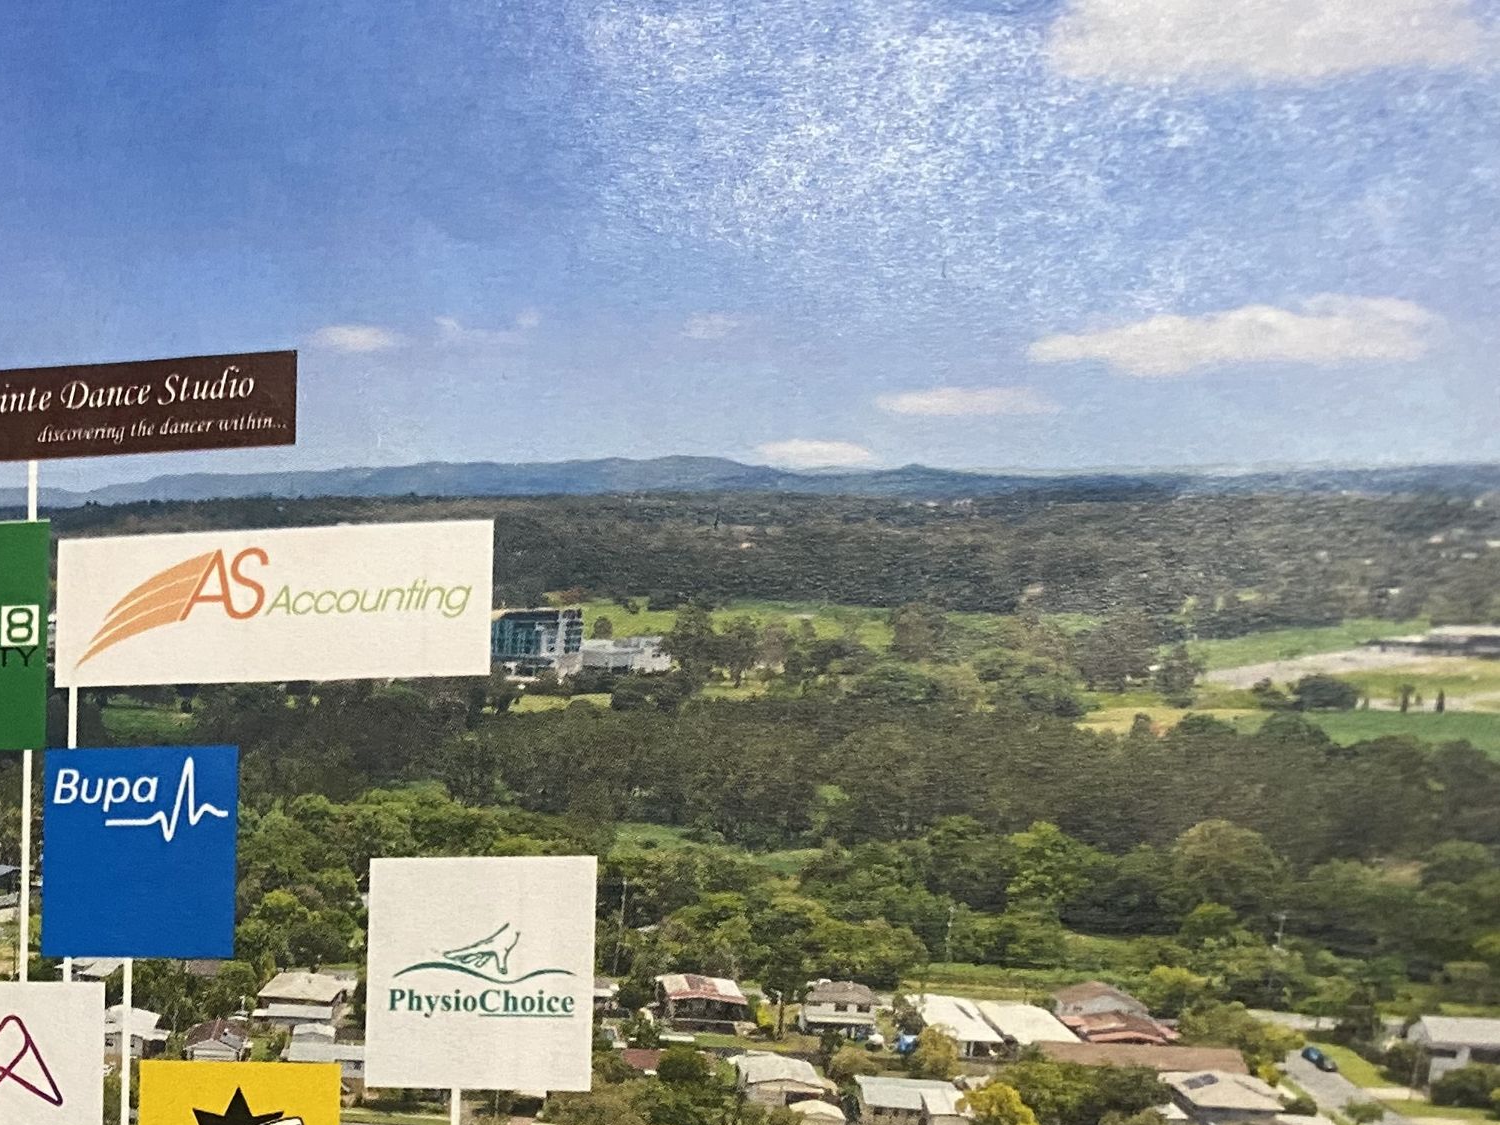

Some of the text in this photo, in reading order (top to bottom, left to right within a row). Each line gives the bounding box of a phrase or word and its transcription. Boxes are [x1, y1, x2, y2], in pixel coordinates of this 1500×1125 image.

[60, 380, 150, 410] Dance
[157, 365, 255, 406] Studio
[37, 423, 126, 444] discovering
[130, 418, 155, 437] the
[159, 416, 214, 435] dancer
[179, 547, 270, 621] AS
[265, 579, 473, 619] Accounting
[52, 768, 158, 813] Bupa
[388, 988, 575, 1018] PhysioChoice
